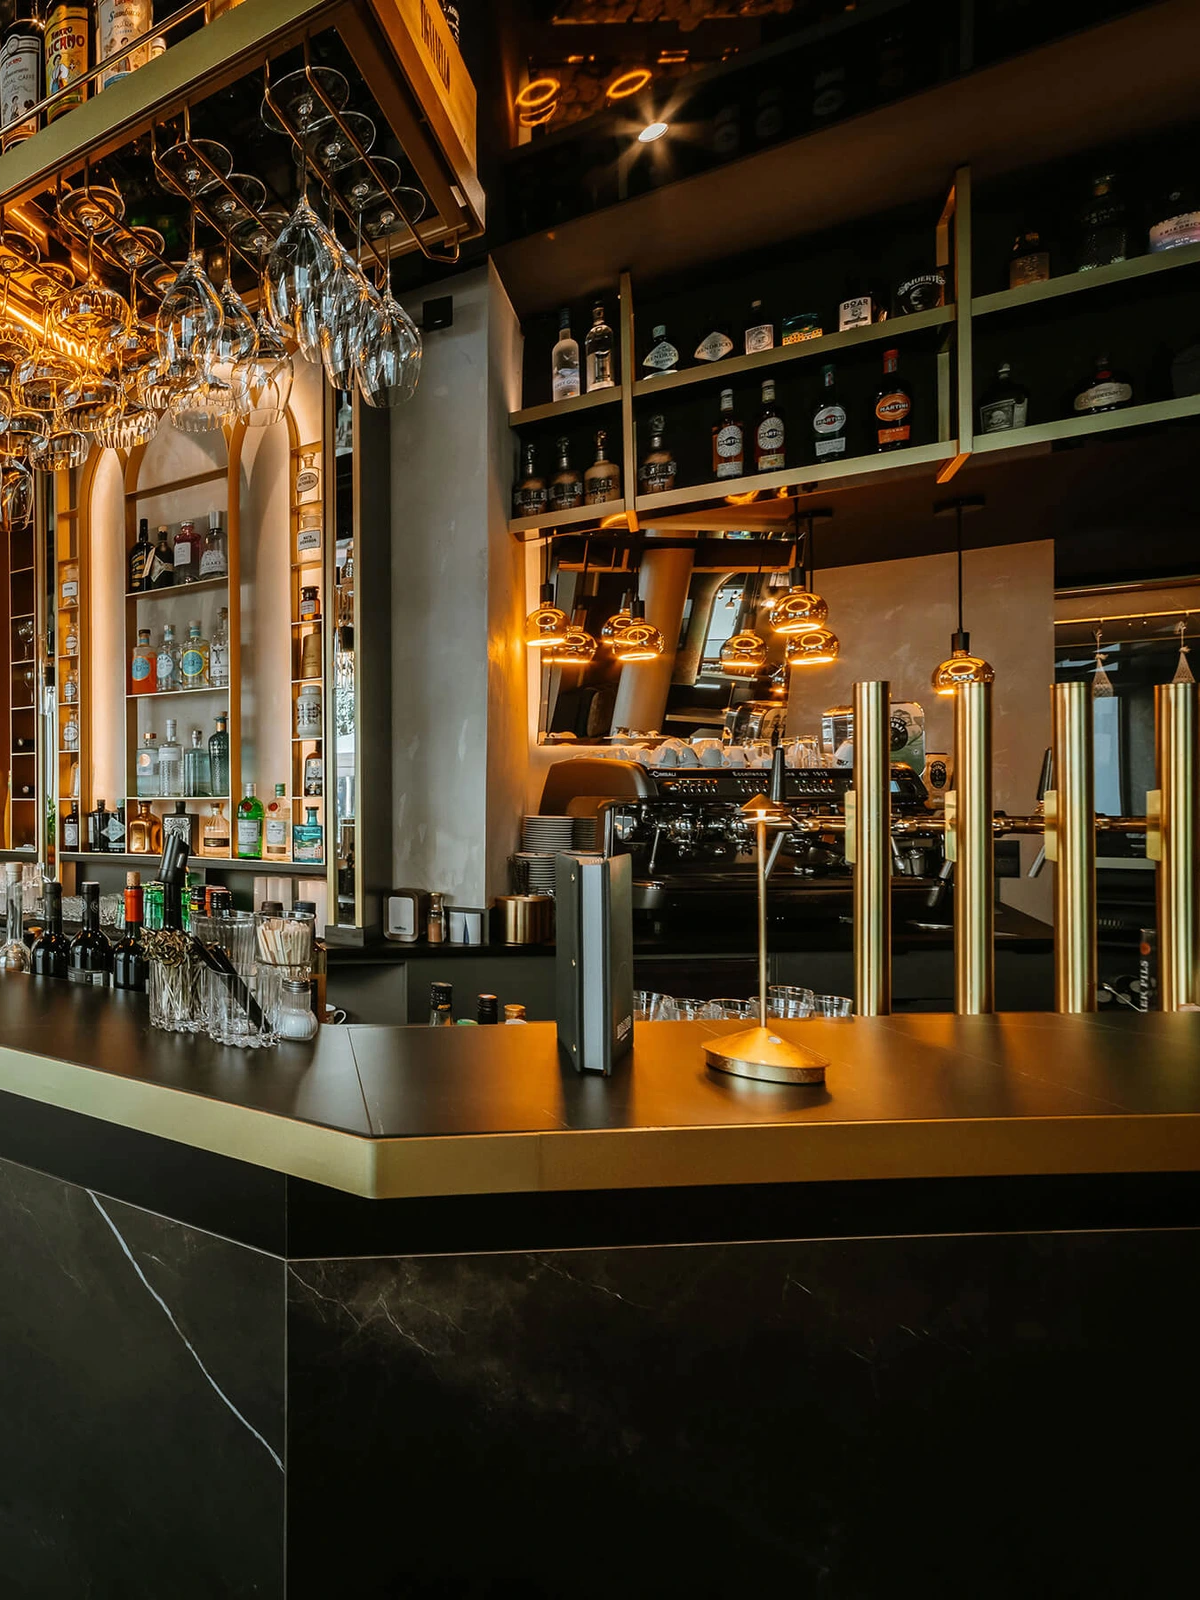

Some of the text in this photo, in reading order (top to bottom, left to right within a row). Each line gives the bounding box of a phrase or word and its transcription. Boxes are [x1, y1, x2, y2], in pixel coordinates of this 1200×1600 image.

[843, 299, 869, 311] BOAR
[880, 403, 908, 413] MARTINI
[815, 414, 844, 426] MARTINI
[1140, 960, 1149, 988] PILS
